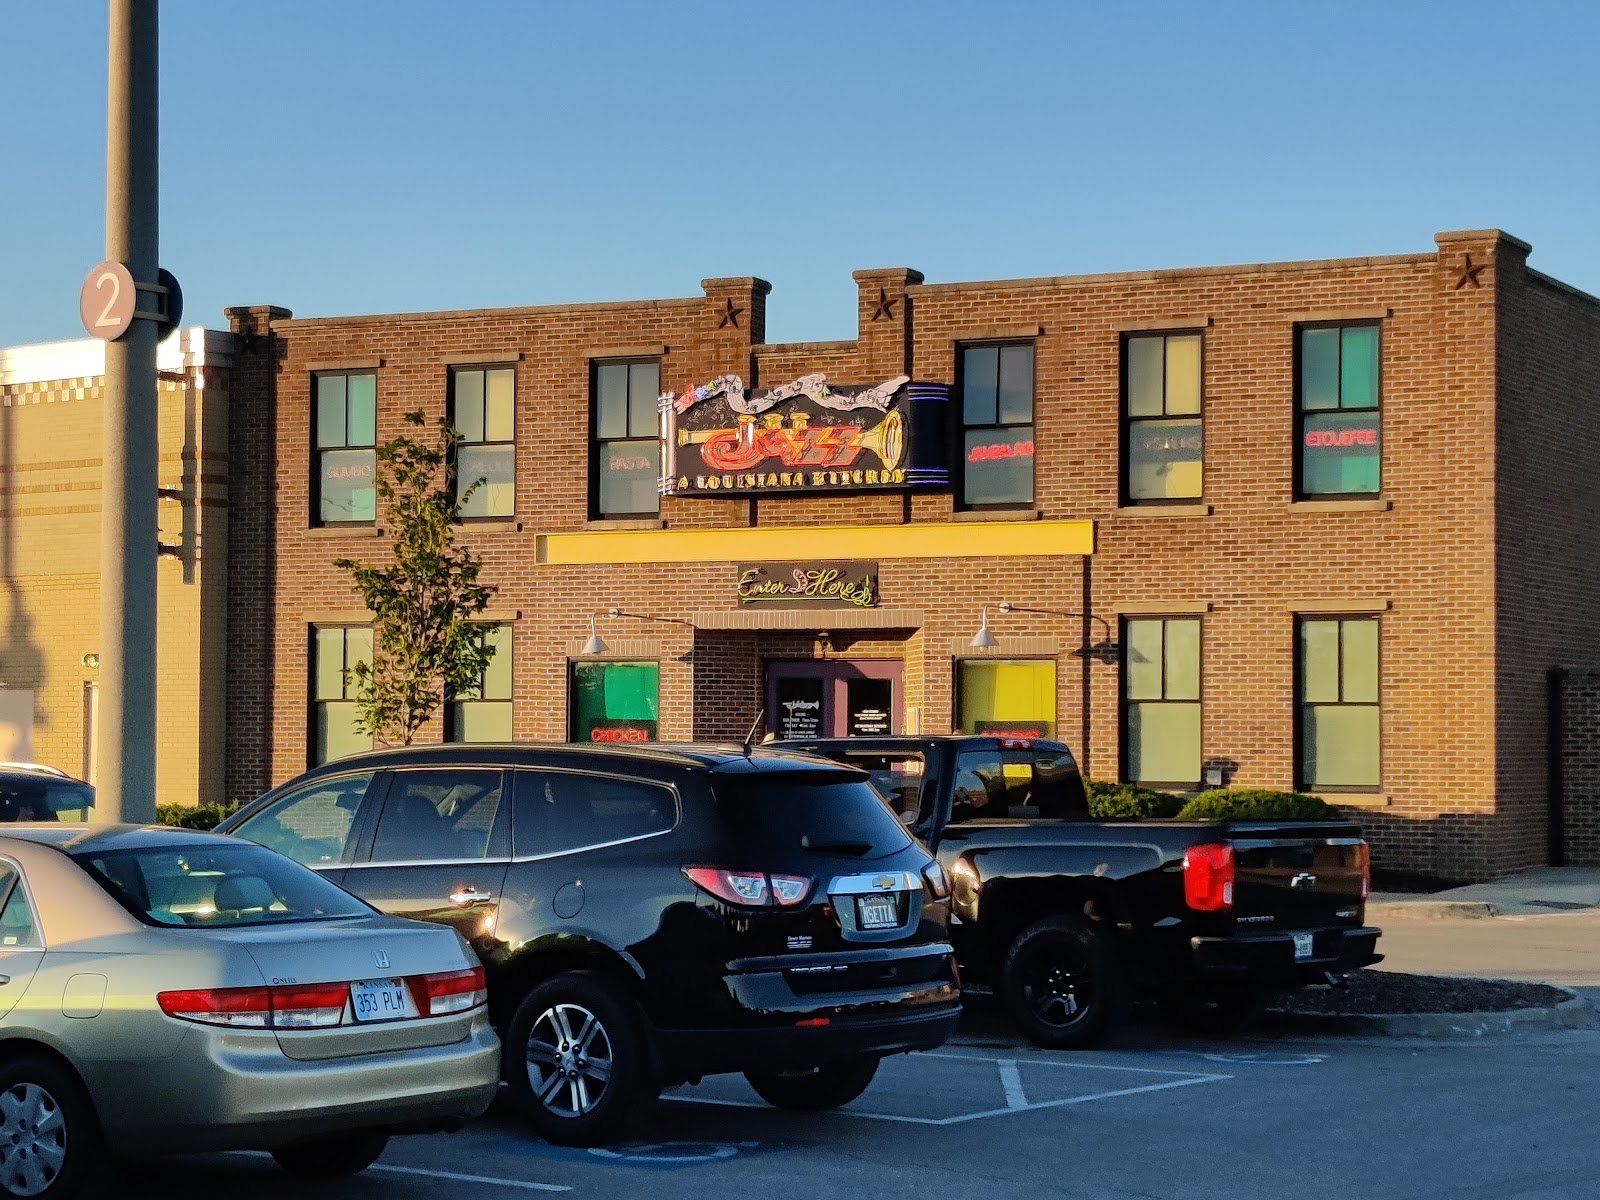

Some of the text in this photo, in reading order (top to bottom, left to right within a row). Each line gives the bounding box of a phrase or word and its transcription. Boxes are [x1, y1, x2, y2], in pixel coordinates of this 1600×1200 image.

[95, 273, 121, 327] 2
[677, 469, 906, 490] A LOUISIANA KITCHEN
[738, 568, 856, 597] Enter Here
[591, 727, 649, 743] CHICKEN
[357, 990, 405, 1013] 353 PLM
